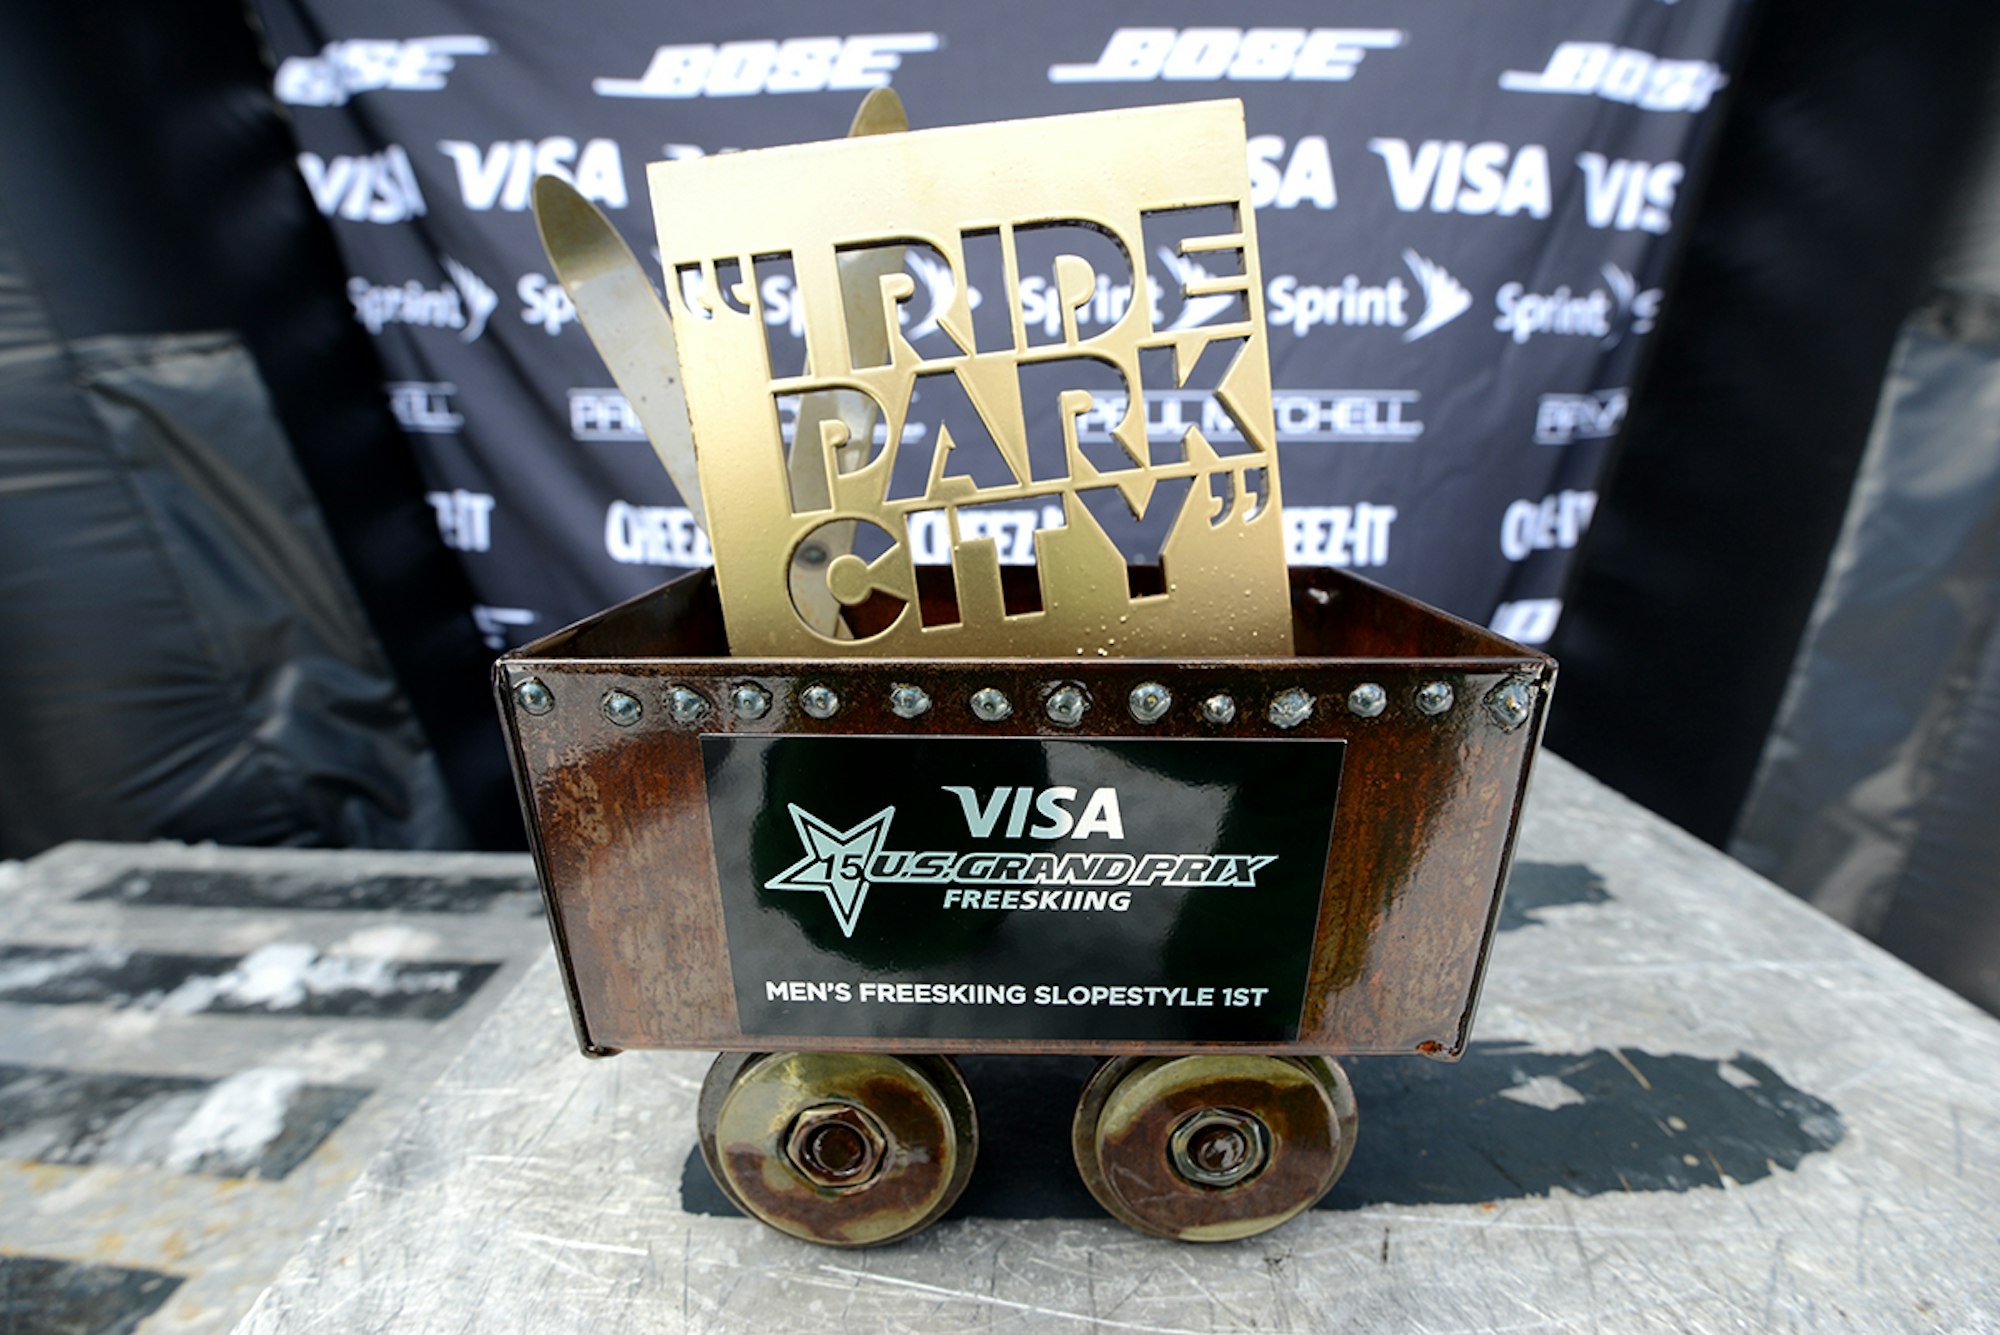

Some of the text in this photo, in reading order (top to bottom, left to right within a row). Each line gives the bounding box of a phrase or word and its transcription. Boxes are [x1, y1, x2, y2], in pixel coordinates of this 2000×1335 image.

[593, 32, 942, 98] BOSE
[1048, 27, 1405, 83] BOSE
[1246, 135, 1338, 210] SA
[1368, 137, 1552, 219] VISA
[1575, 151, 1686, 235] VIS
[833, 199, 1254, 375] RIDE
[1268, 275, 1409, 335] Sprint
[772, 335, 1268, 519] PARK
[941, 785, 1125, 840] VISA
[820, 852, 867, 882] 15
[942, 888, 1132, 912] FREESKIING
[858, 982, 1027, 1006] FREESKIING
[1033, 984, 1216, 1008] SLOPESTYLE
[1222, 986, 1270, 1008] 1ST
